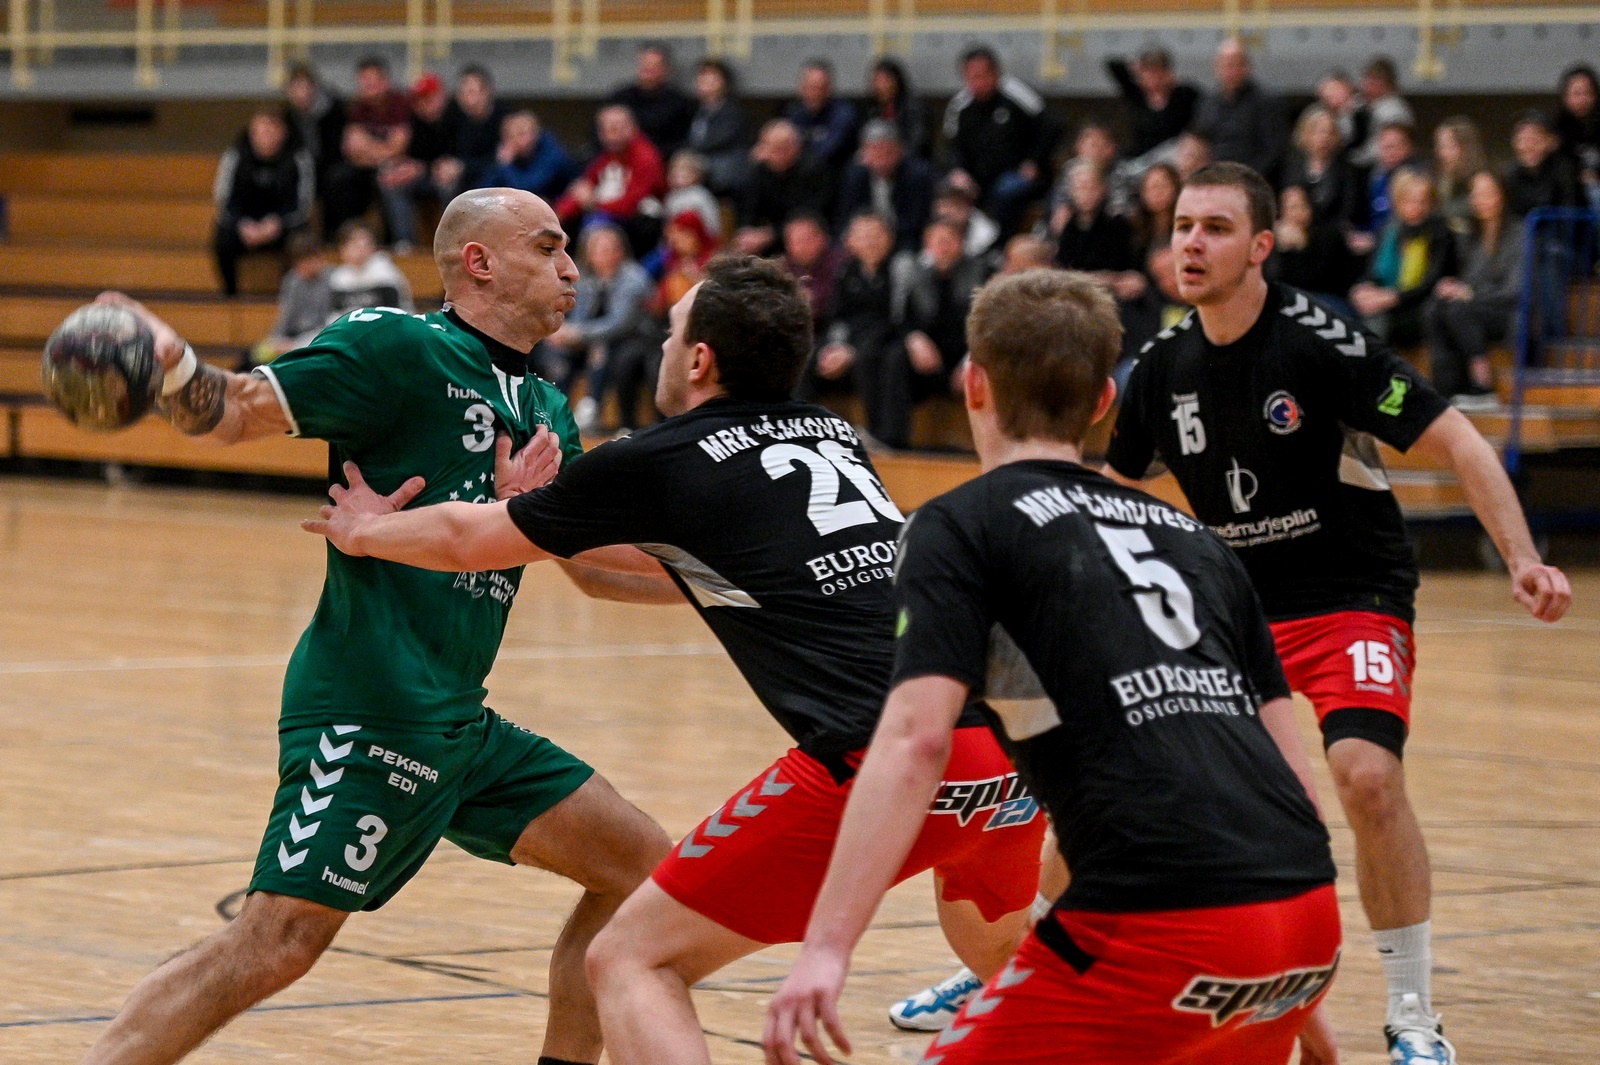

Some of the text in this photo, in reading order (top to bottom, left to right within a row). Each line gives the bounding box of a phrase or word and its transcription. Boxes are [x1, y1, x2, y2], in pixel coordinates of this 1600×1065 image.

[462, 403, 496, 453] 3
[697, 425, 760, 463] MRK
[1171, 402, 1208, 456] 15
[760, 440, 906, 537] 26
[1013, 487, 1080, 528] MRK
[1094, 522, 1200, 651] 5
[1346, 640, 1394, 685] 15
[367, 744, 439, 784] PEKARA
[387, 772, 418, 795] EDI
[344, 814, 389, 872] 3
[321, 865, 370, 896] hummel
